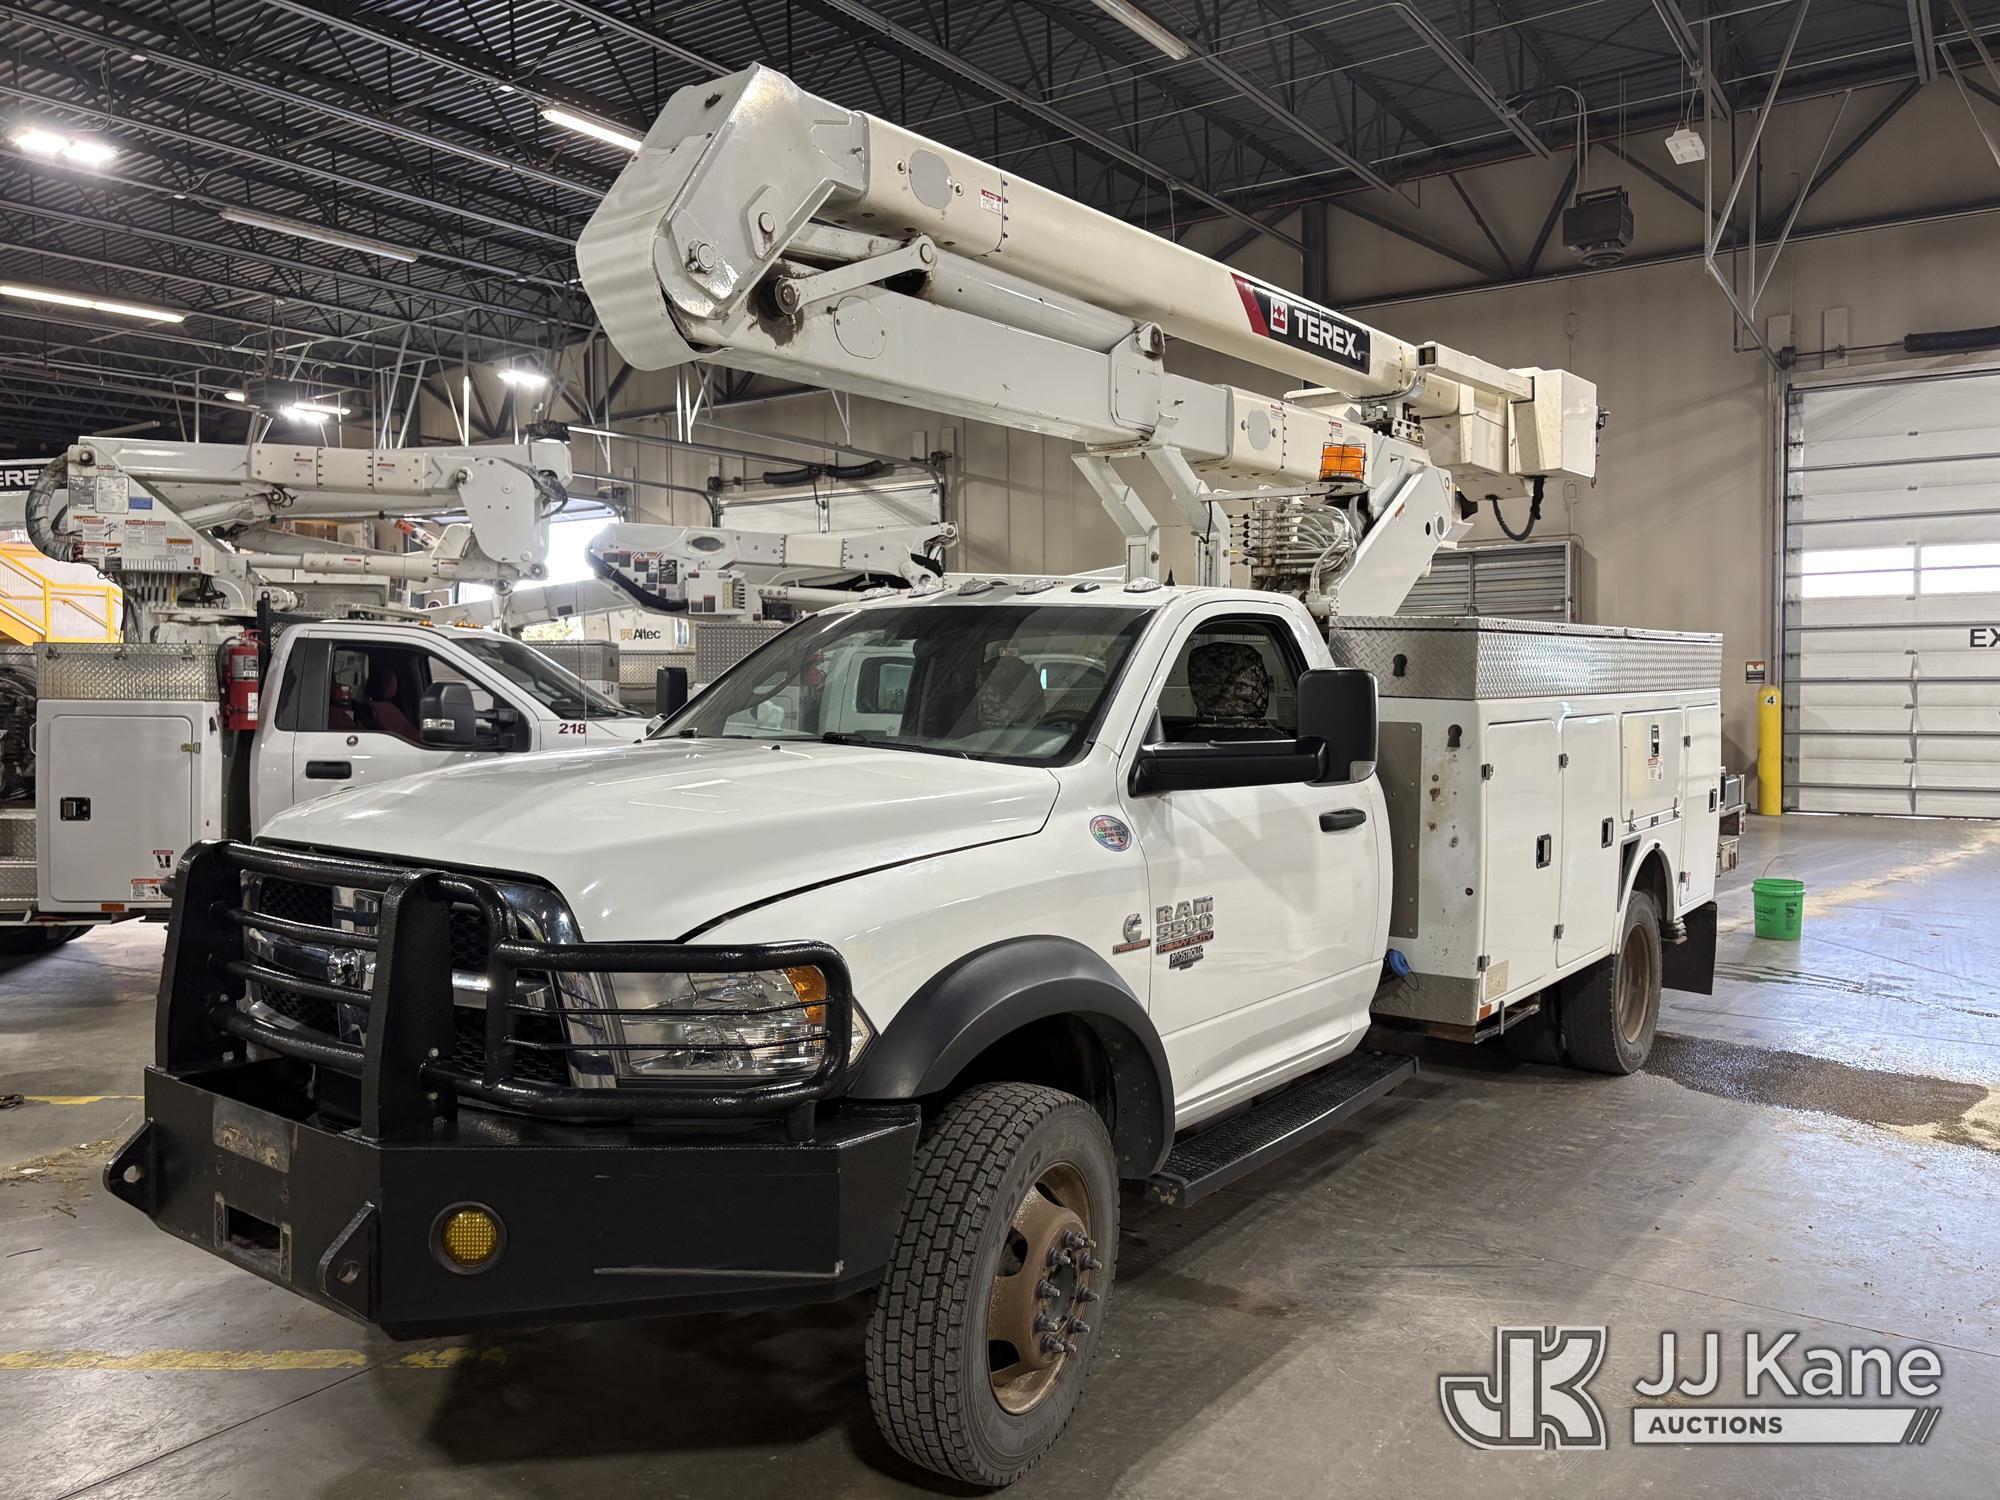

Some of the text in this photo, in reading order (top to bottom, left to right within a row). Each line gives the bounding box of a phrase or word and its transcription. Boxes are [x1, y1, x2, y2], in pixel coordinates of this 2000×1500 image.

[1294, 309, 1357, 359] TEREX
[633, 628, 661, 640] Altec
[1767, 695, 1775, 705] 4
[558, 723, 586, 734] 218
[1156, 895, 1214, 925] RAM
[1156, 912, 1214, 943] 5500
[1160, 937, 1189, 953] HEAVY
[1190, 932, 1213, 946] DUTY
